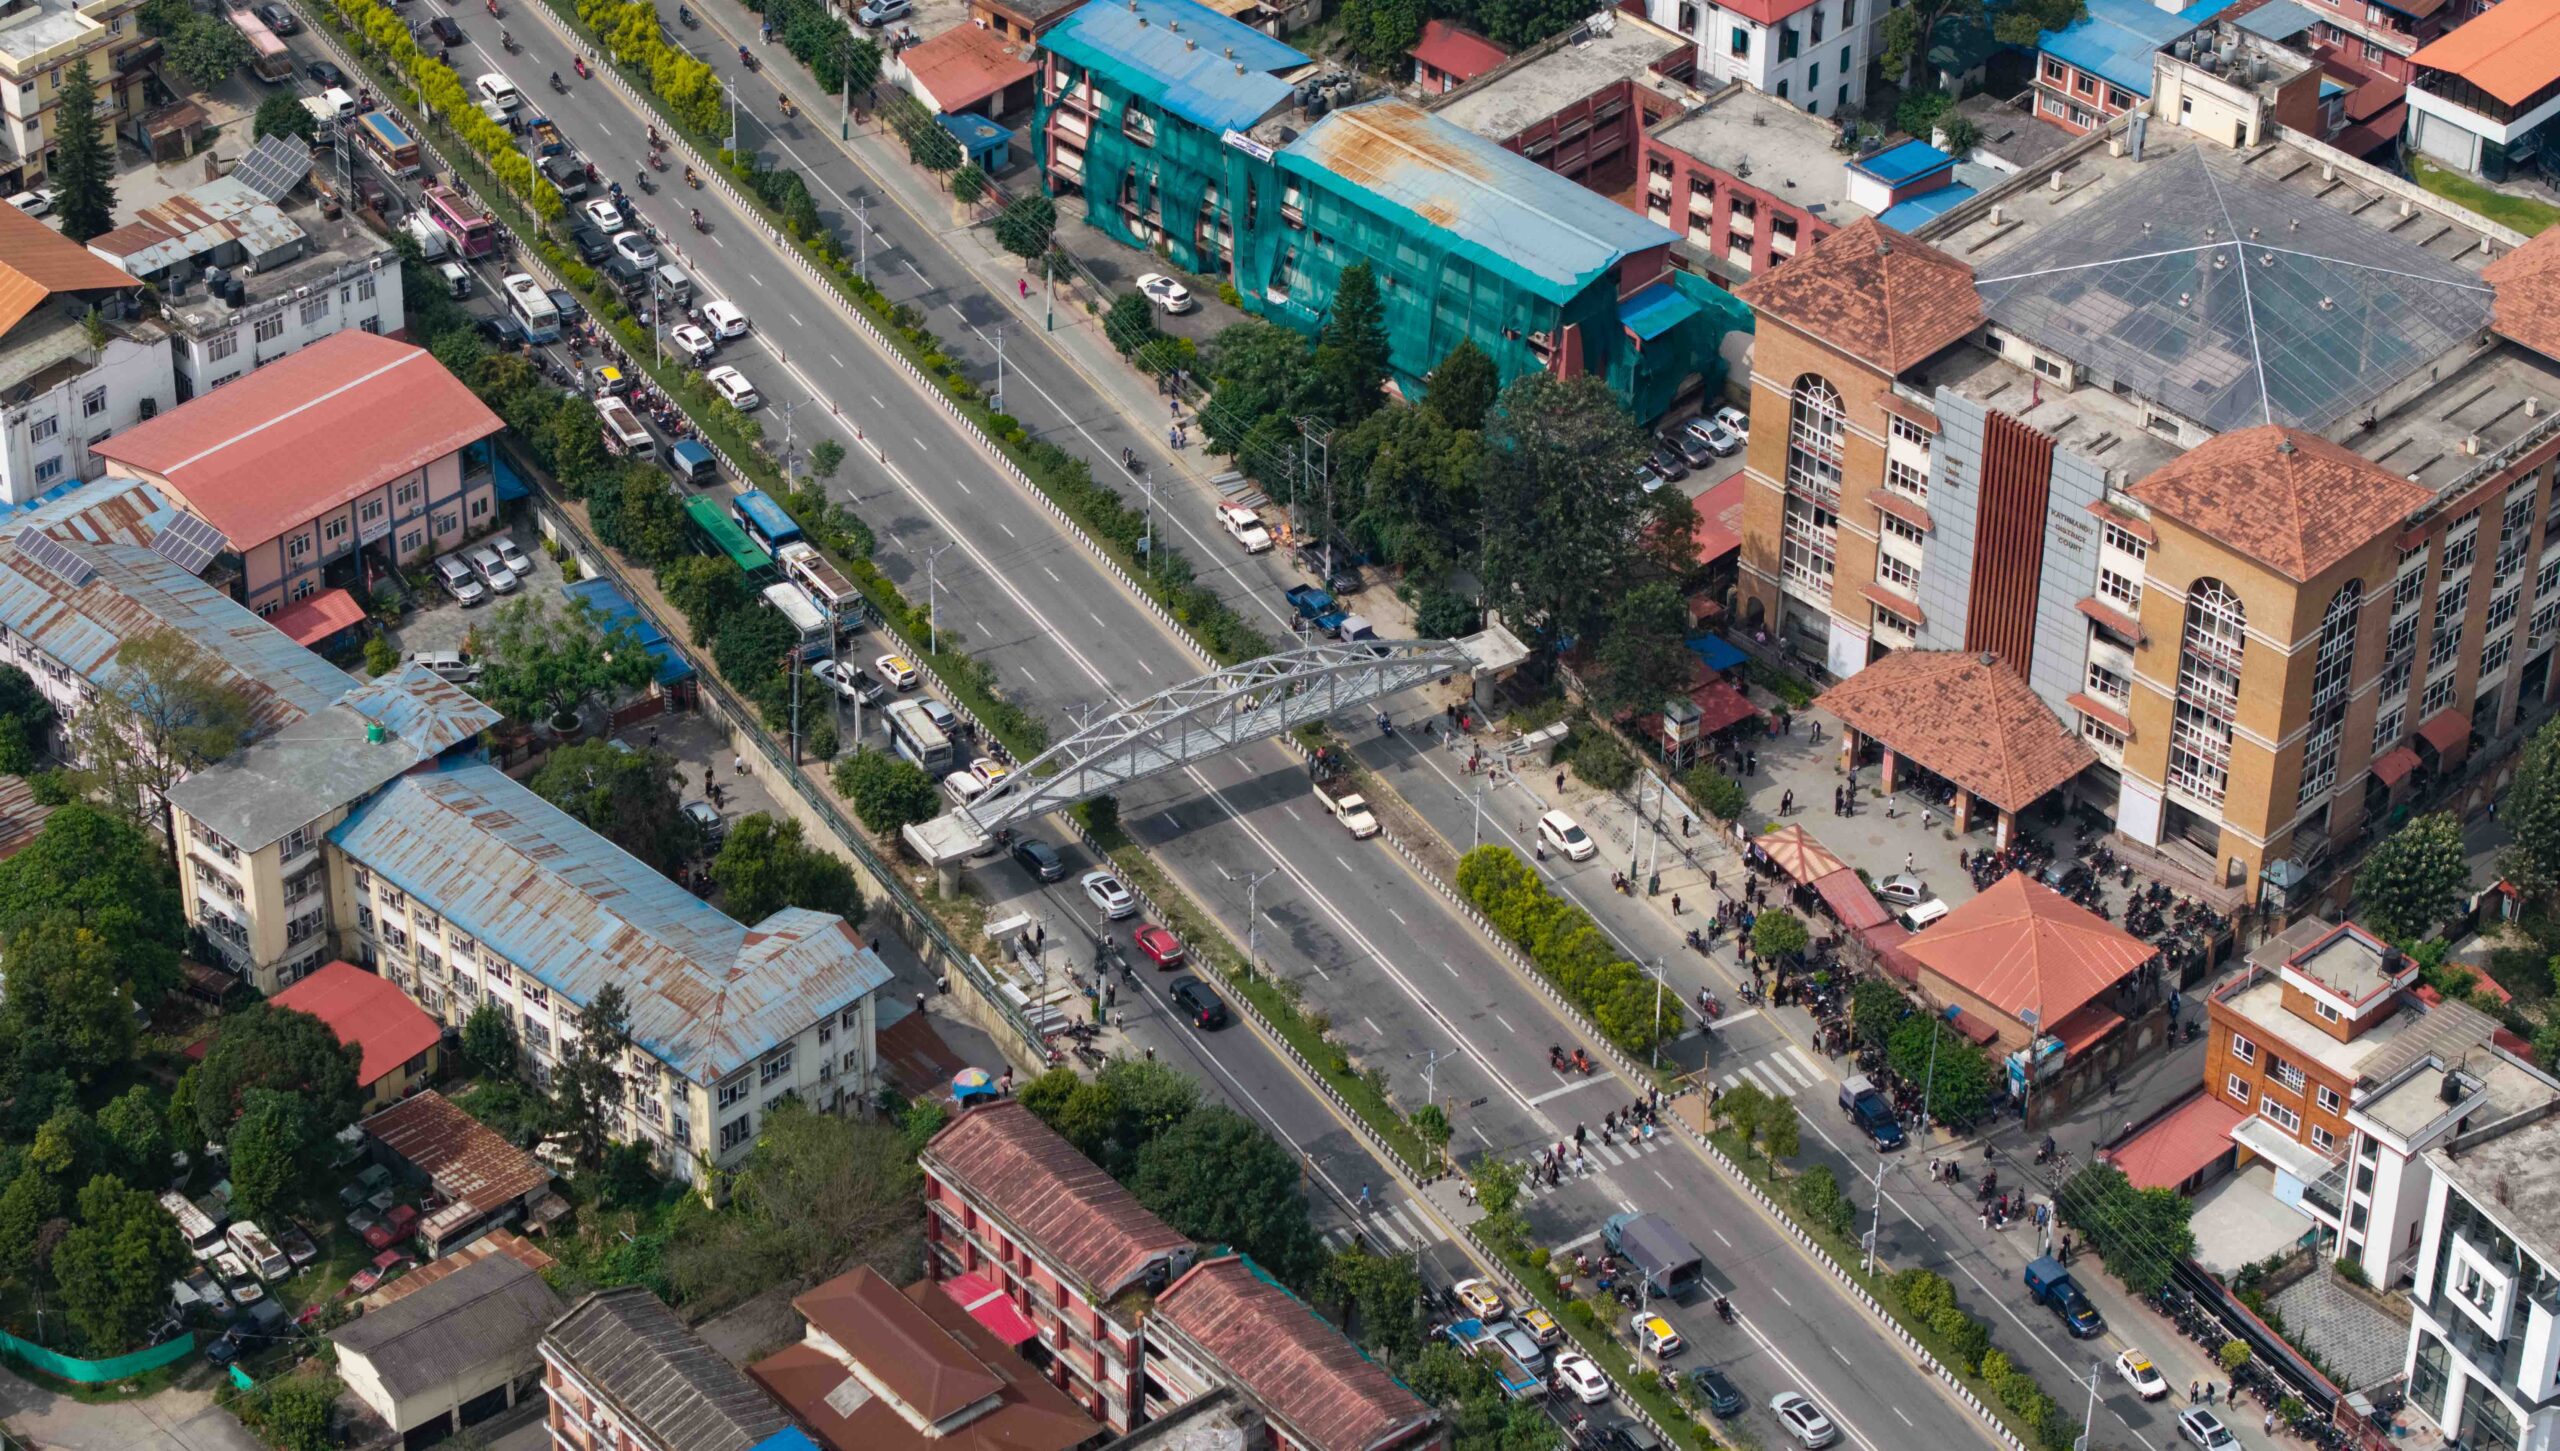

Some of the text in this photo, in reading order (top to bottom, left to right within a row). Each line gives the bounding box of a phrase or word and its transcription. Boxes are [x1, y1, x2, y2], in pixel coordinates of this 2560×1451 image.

[2051, 509, 2093, 535] KATHMANDU
[2055, 524, 2086, 543] DISTRICT
[2058, 537, 2082, 552] COURT
